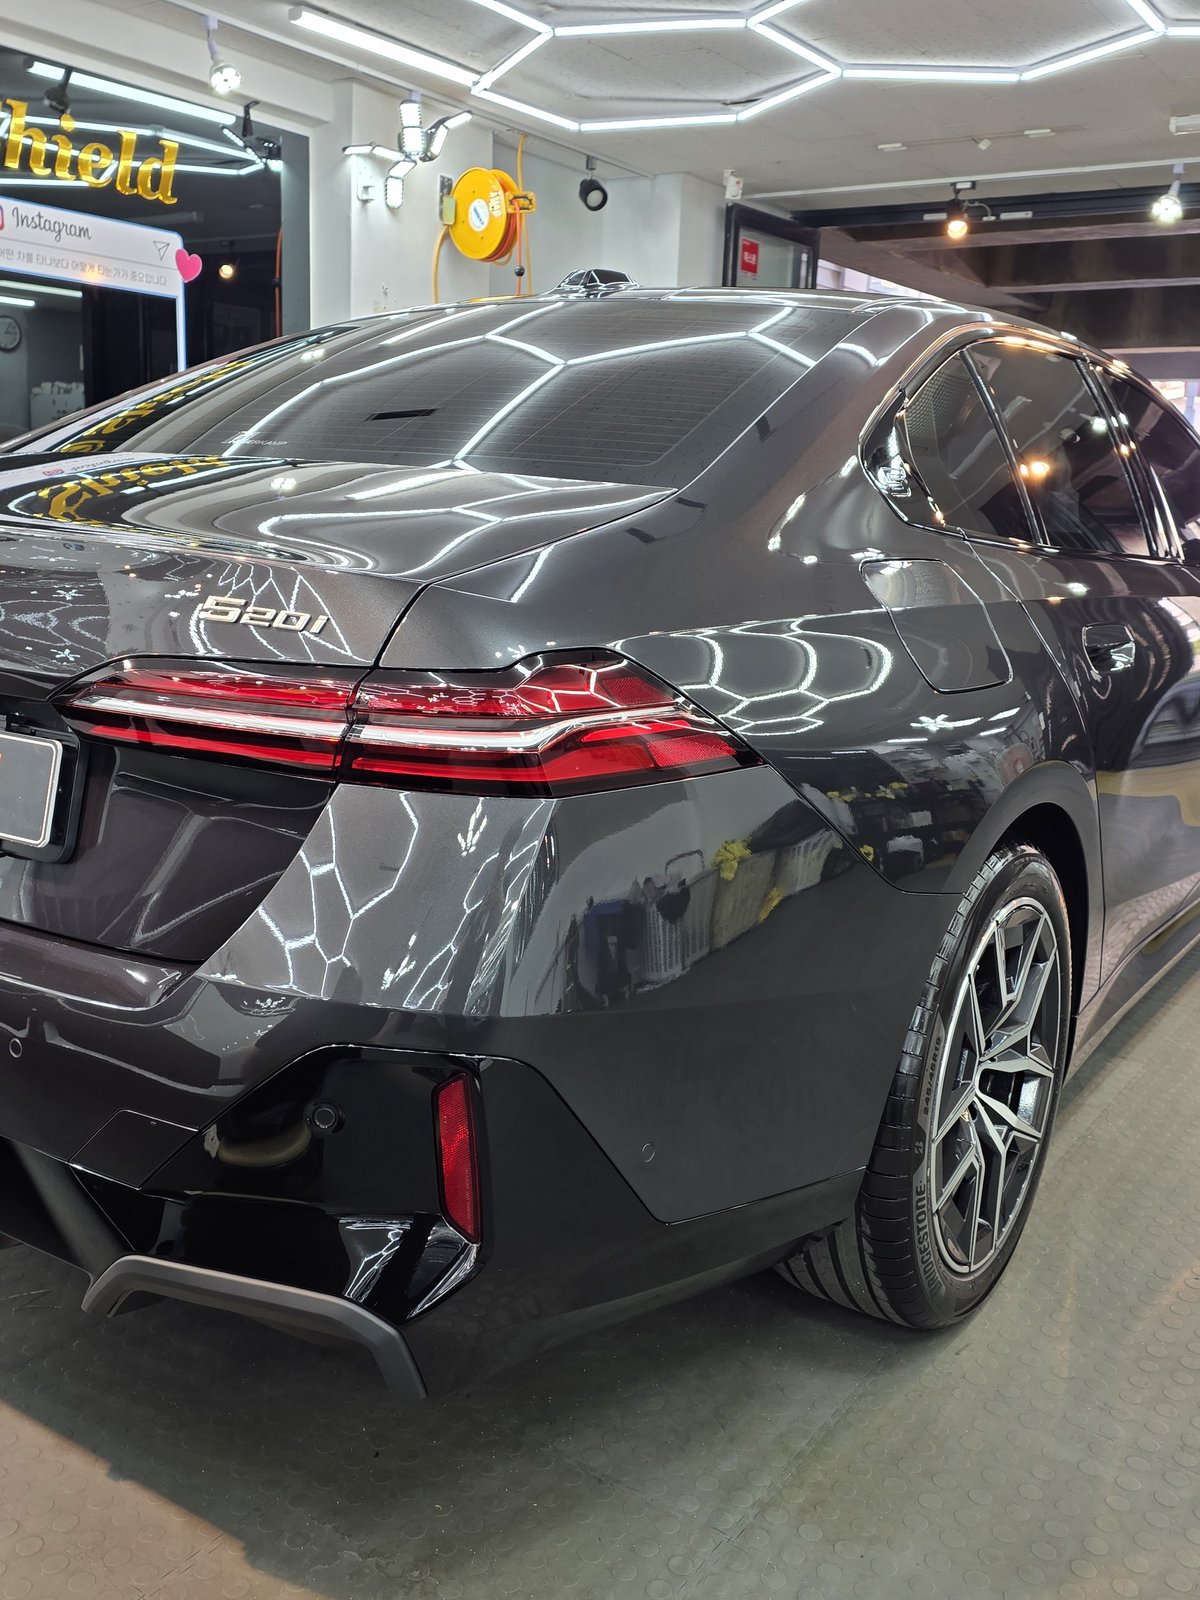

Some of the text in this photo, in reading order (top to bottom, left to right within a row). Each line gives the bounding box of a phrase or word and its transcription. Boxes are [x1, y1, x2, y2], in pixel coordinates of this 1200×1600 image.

[0, 98, 180, 205] hield
[12, 206, 93, 242] Instagram
[200, 595, 330, 634] 520i
[915, 1183, 942, 1297] BRIDGESTONE
